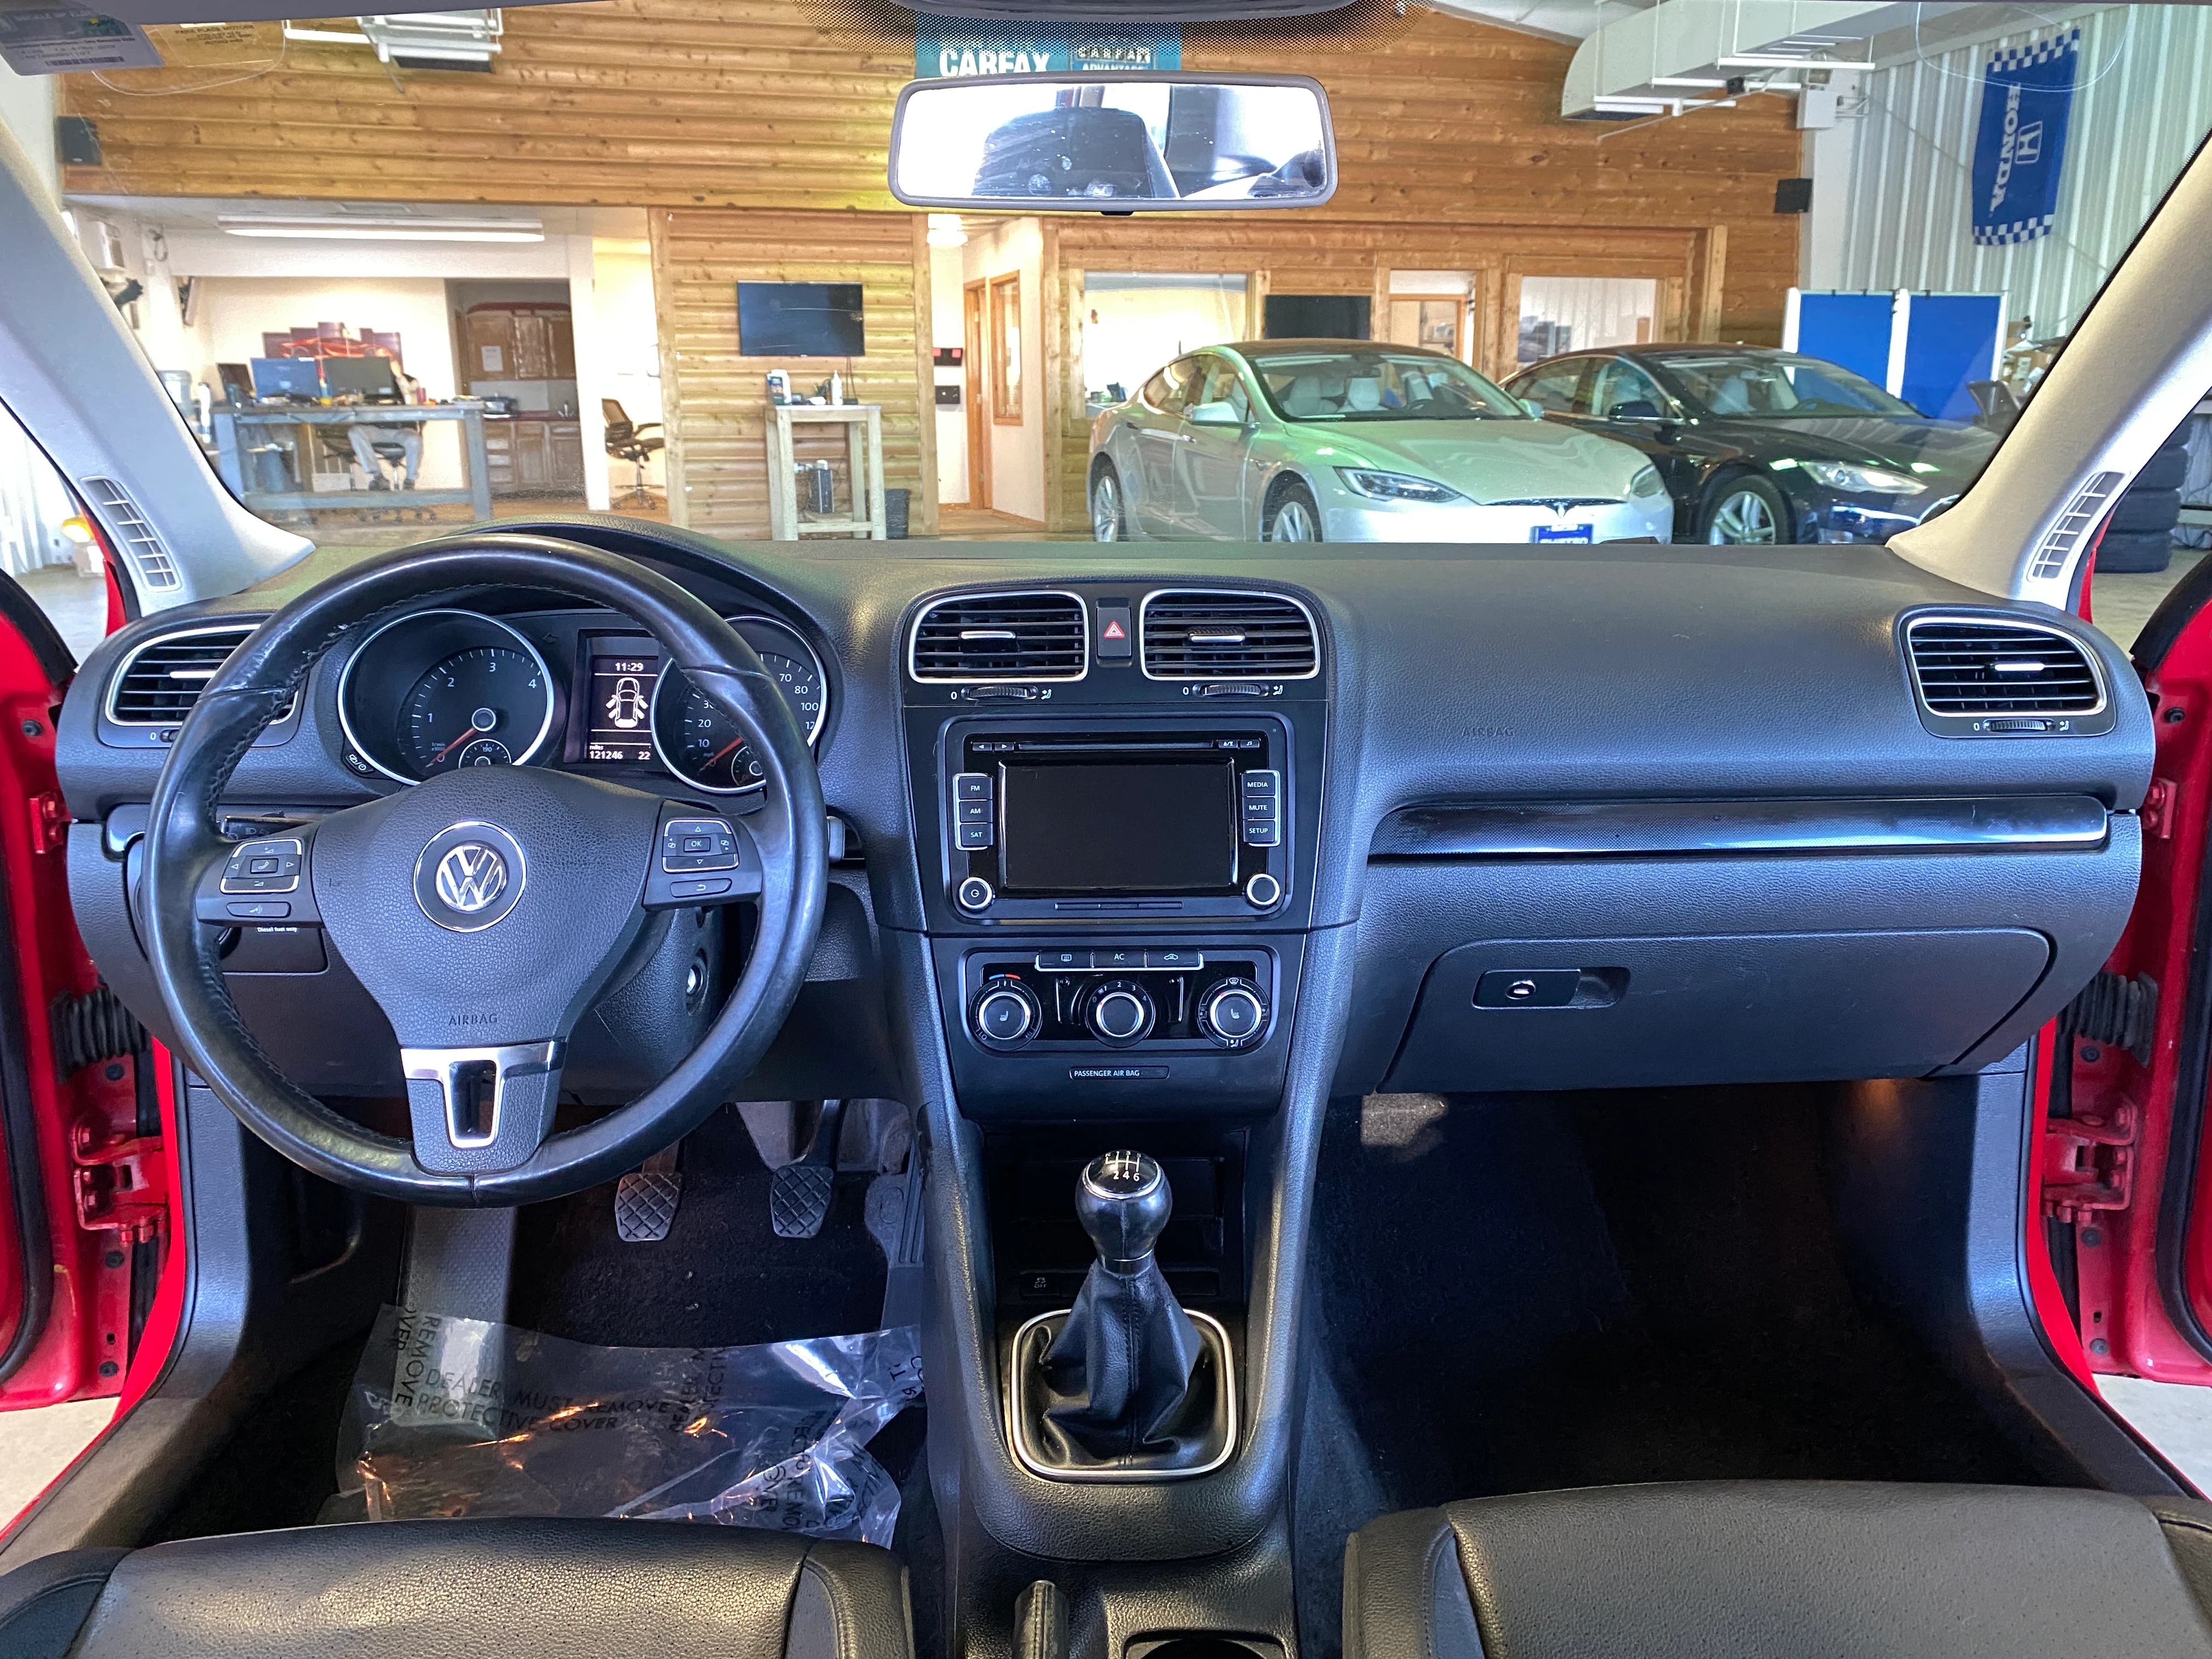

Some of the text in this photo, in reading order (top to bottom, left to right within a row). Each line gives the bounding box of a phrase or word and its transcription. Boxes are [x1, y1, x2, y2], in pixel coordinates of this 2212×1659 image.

[1077, 46, 1152, 63] CARFAX
[939, 47, 1049, 77] CARFAX
[1989, 82, 2021, 212] HONDA
[489, 662, 496, 672] 3
[615, 662, 644, 672] 11:29
[448, 677, 455, 687] 2
[779, 673, 792, 682] 70
[528, 679, 537, 689] 4
[794, 686, 808, 695] 80
[951, 691, 957, 700] 0
[1182, 687, 1189, 695] 0
[800, 702, 819, 711] 100
[427, 713, 433, 723] 1
[698, 719, 712, 727] 20
[805, 721, 815, 730] 12
[1973, 723, 1980, 731] 0
[1462, 727, 1514, 736] AIRBAG
[698, 739, 710, 748] 10
[589, 751, 651, 760] 121246 22
[448, 1013, 498, 1025] AIRBAG
[1113, 1171, 1140, 1181] 2 4 6
[394, 1317, 442, 1407] REMOVE
[426, 1368, 502, 1399] DEALER
[415, 1392, 618, 1431] PROTECTIVE COVER
